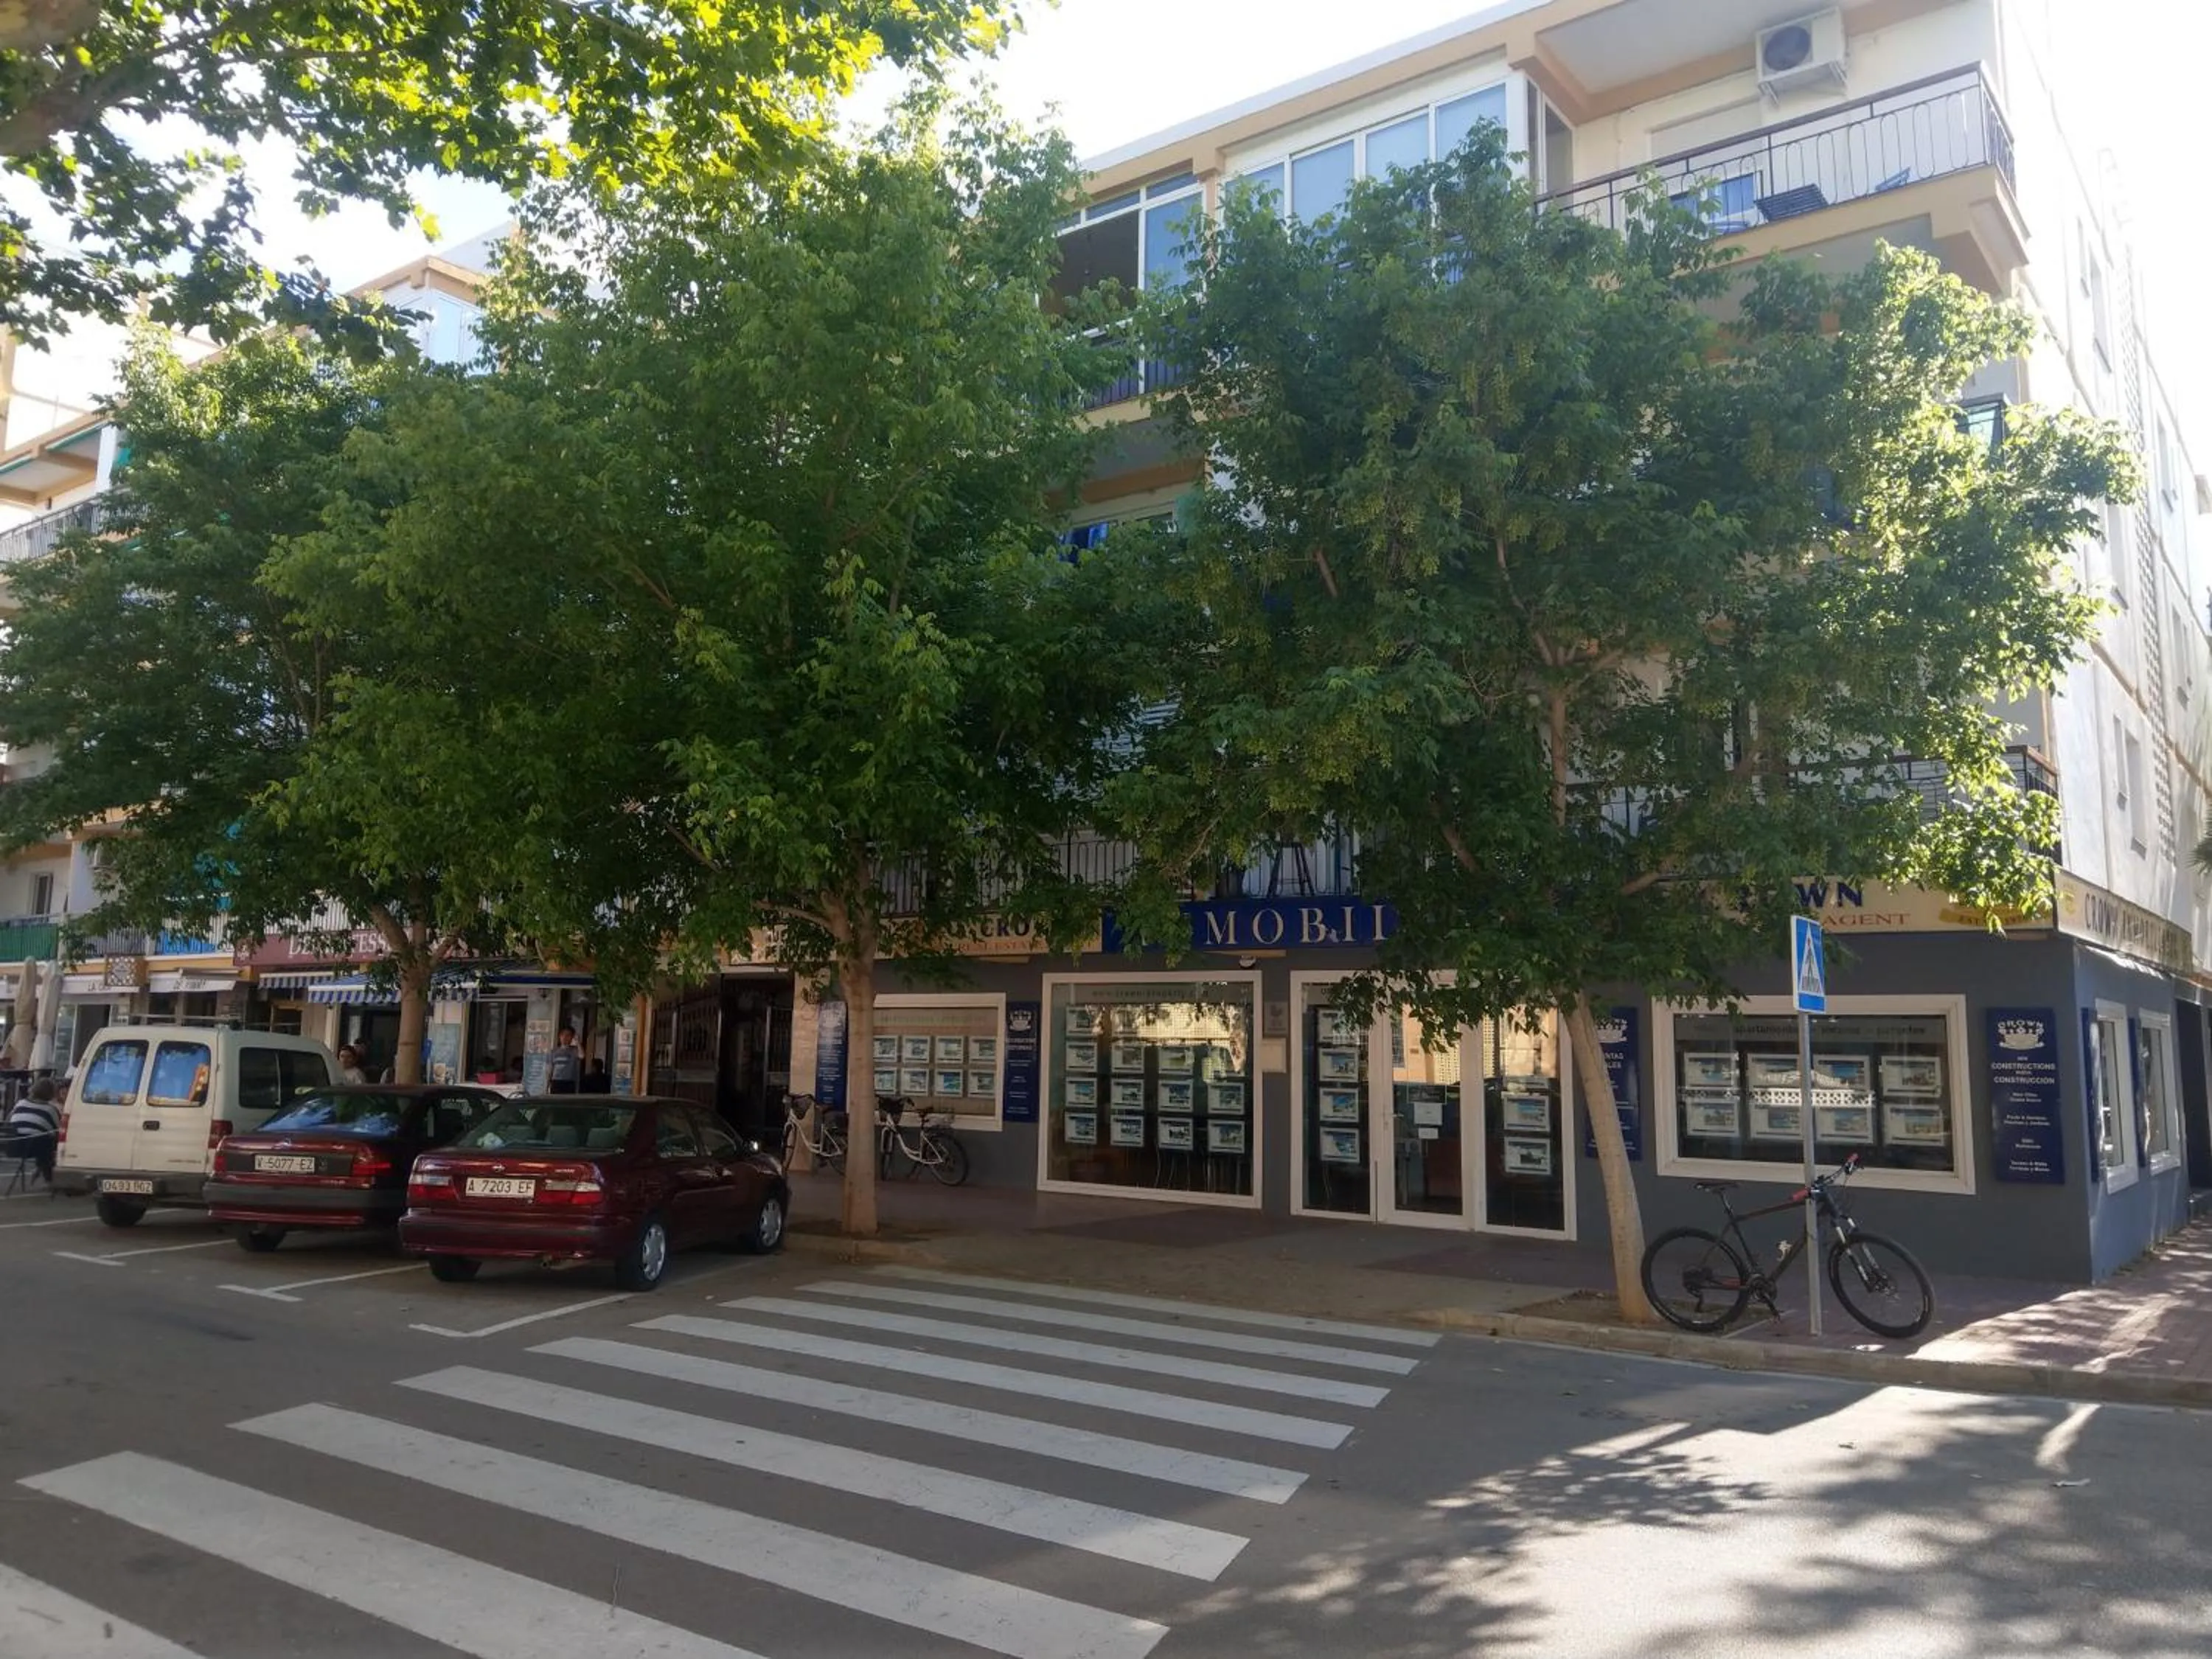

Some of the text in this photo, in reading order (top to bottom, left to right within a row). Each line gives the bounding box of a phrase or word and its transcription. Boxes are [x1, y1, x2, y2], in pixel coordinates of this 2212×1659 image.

[1820, 913, 1911, 926] AGENT
[1992, 1062, 2056, 1071] CONSTRUCTIONS
[468, 1179, 533, 1194] A 7203 EF
